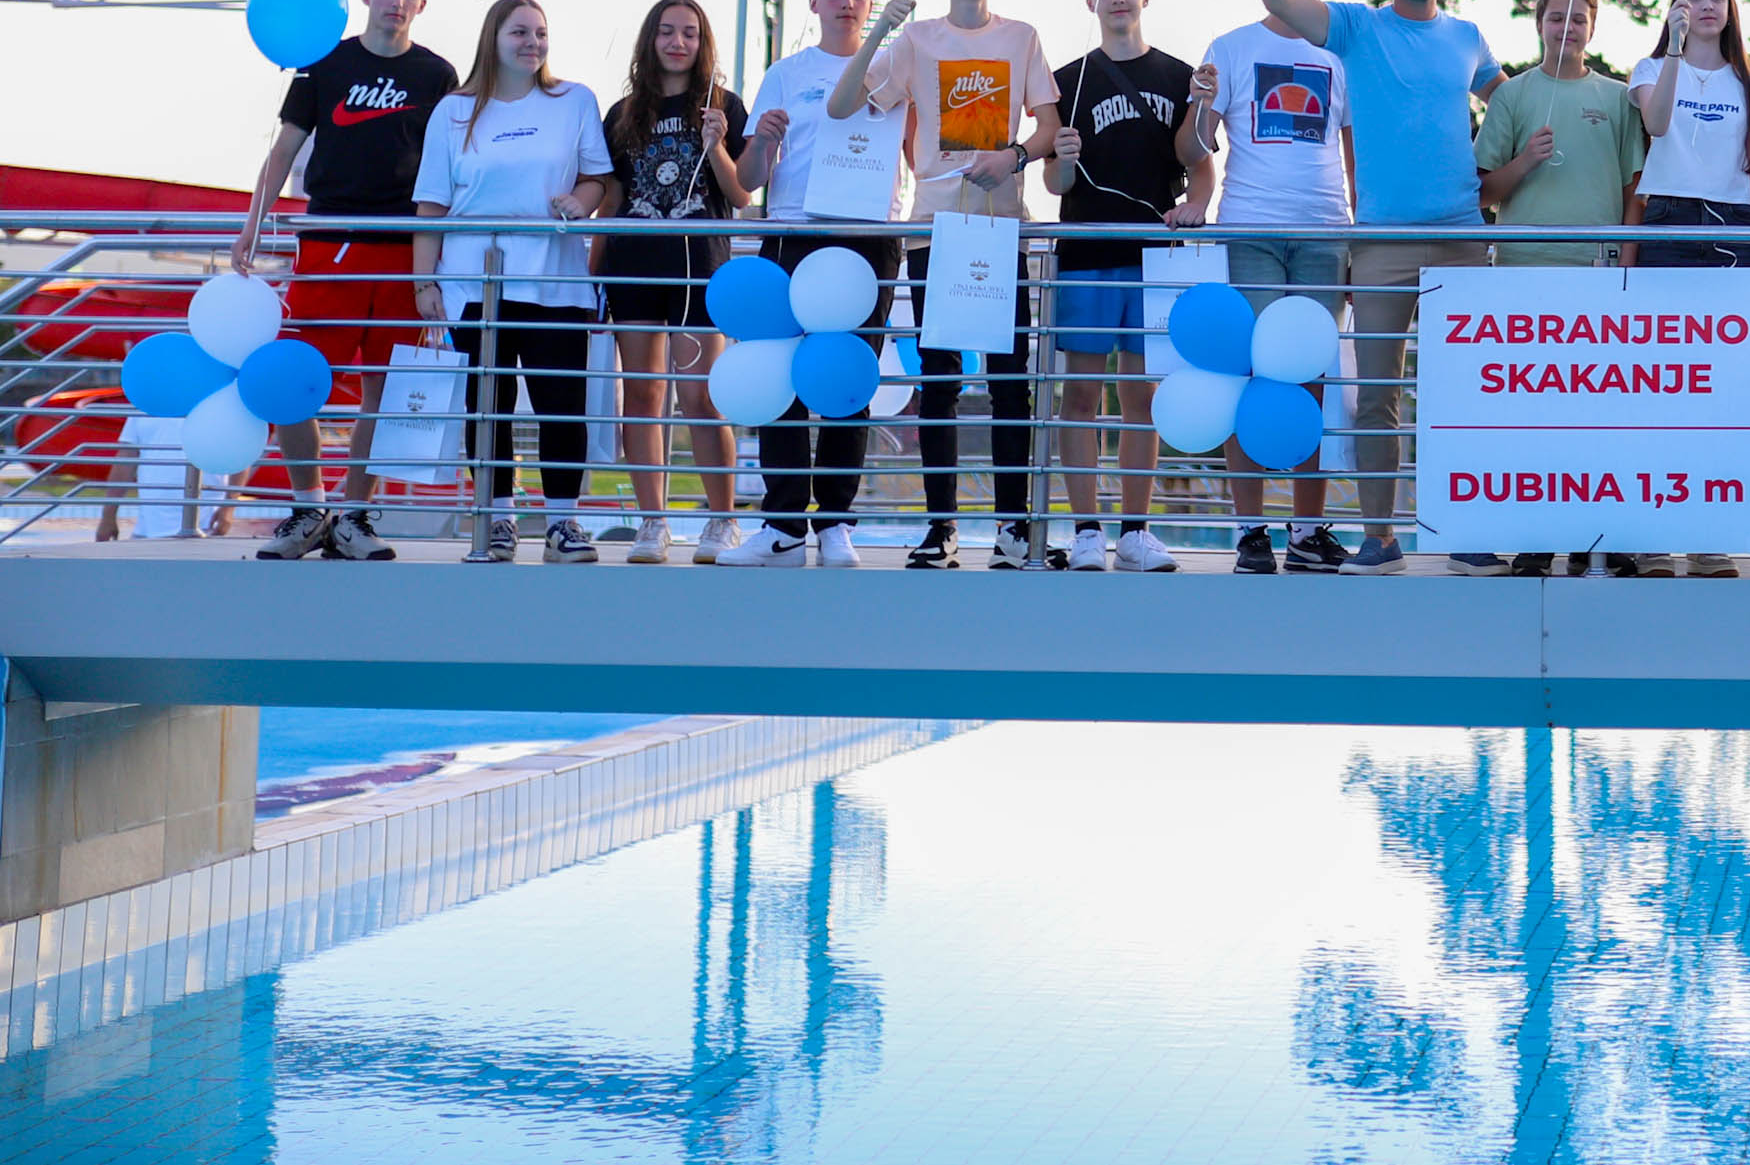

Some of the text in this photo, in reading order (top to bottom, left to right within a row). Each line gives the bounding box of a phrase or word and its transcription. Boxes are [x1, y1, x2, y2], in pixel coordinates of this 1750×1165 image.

[346, 77, 408, 109] nike
[955, 70, 995, 92] nike
[1677, 99, 1739, 114] FREE PATH
[1446, 314, 1749, 344] ZABRANJENO
[1480, 363, 1713, 394] SKAKANJE
[1450, 472, 1744, 509] DUBINA 1,3 m
